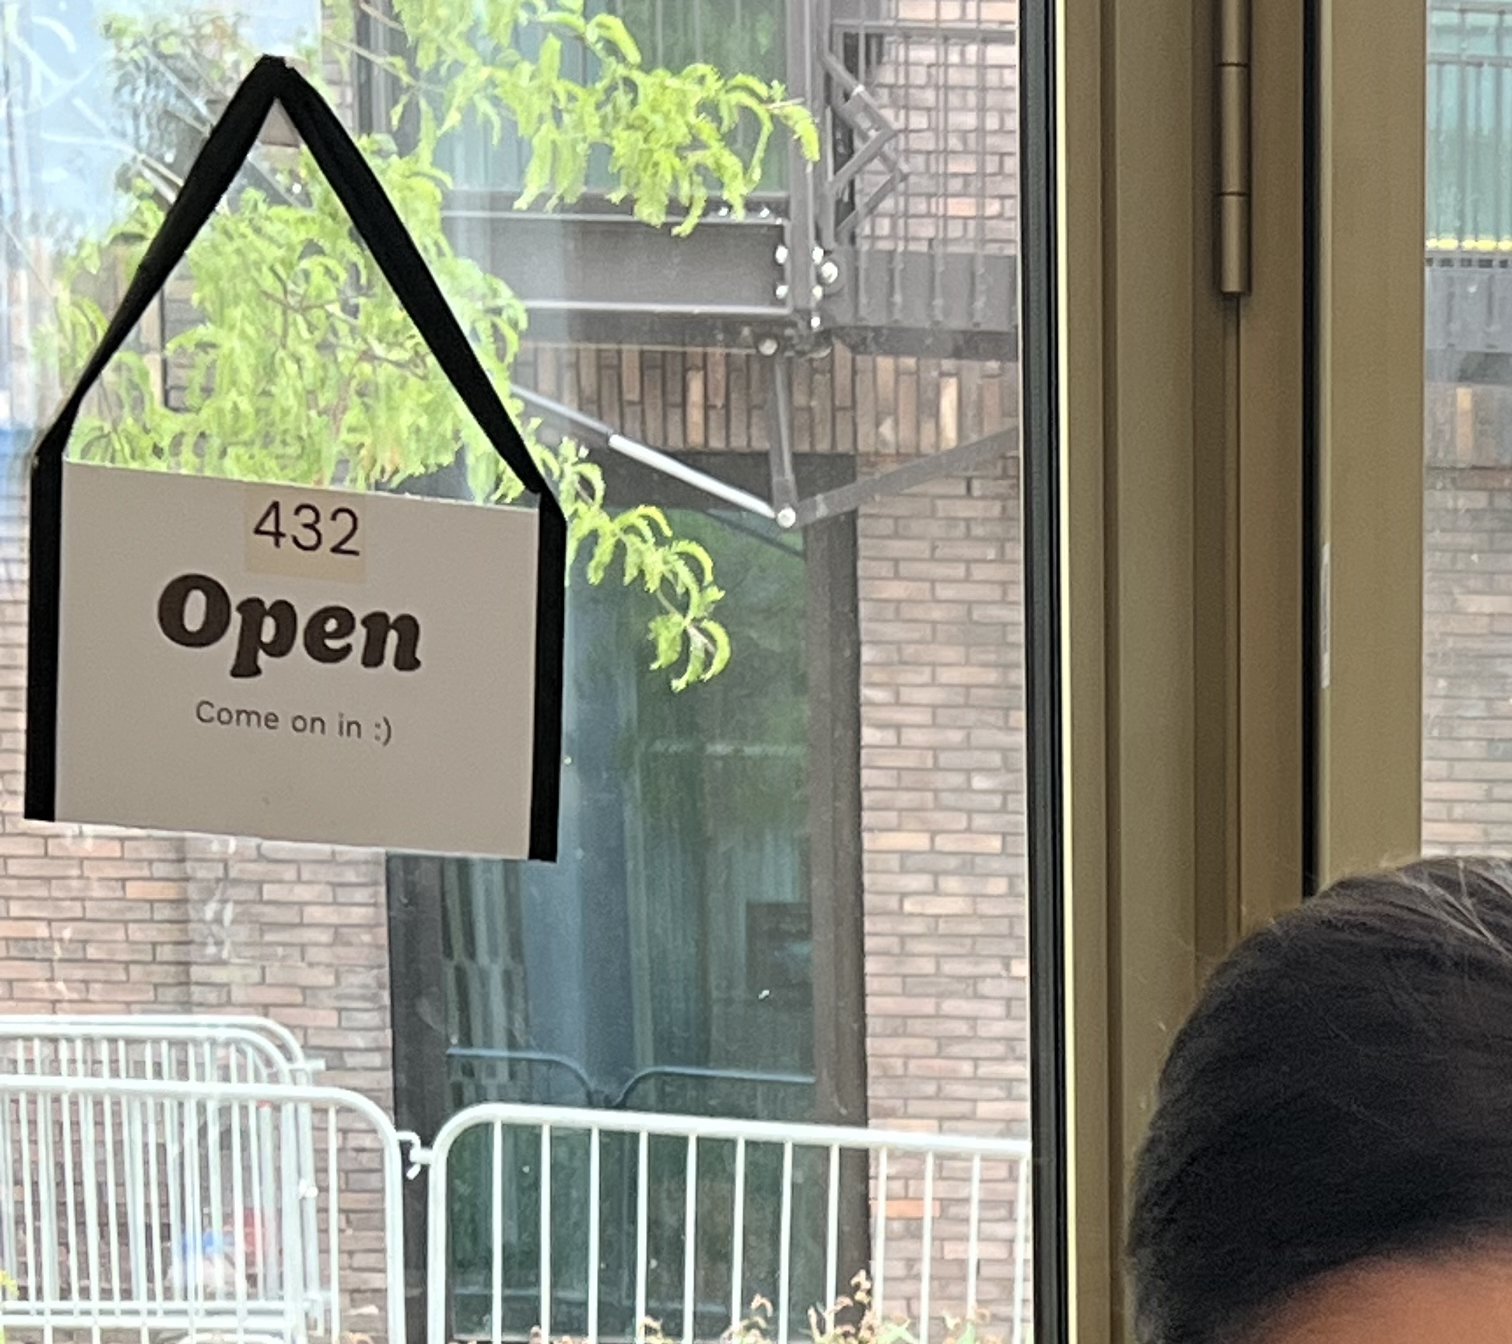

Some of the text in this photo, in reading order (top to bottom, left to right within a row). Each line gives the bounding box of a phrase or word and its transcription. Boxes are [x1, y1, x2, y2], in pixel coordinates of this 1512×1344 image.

[252, 499, 362, 556] 432
[156, 571, 423, 679] Open
[194, 699, 280, 732] Come
[290, 711, 328, 735] on
[337, 712, 364, 740] in
